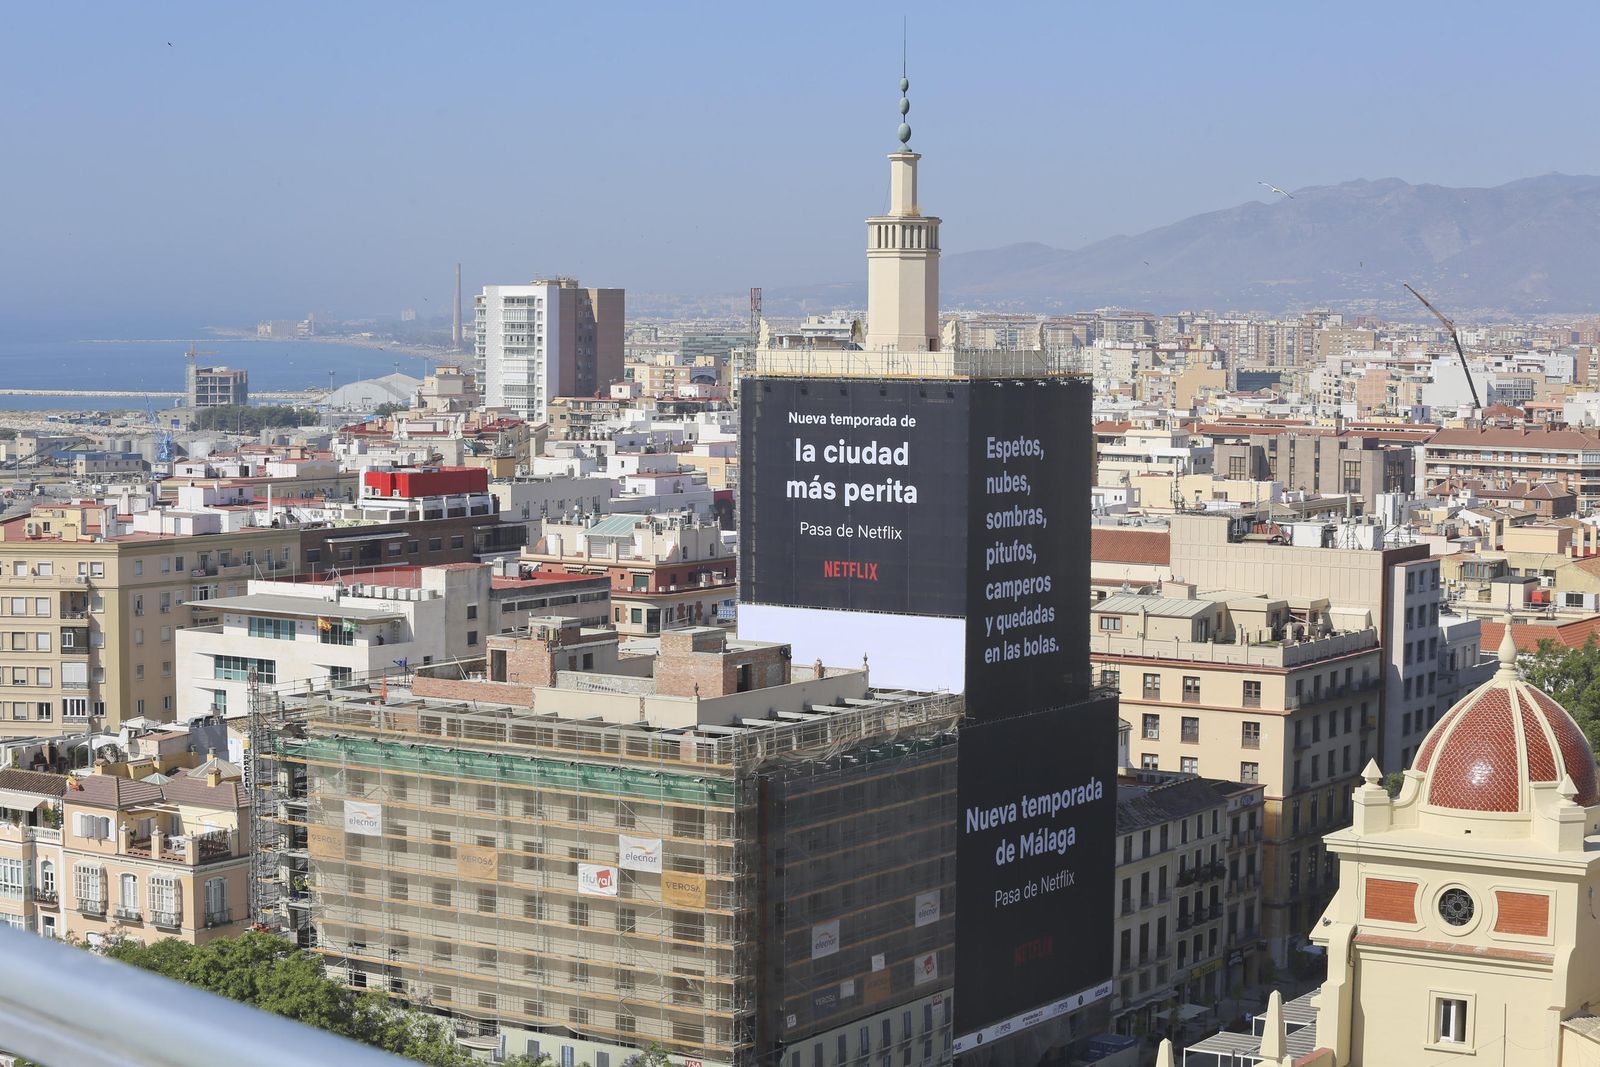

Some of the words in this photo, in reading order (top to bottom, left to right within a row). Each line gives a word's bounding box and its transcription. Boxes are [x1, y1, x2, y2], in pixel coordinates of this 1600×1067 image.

[789, 412, 826, 424] Nueva
[830, 413, 896, 428] temporada
[901, 415, 916, 427] de
[796, 438, 815, 462] la
[824, 439, 908, 465] ciudad
[987, 436, 1044, 462] Espetos,
[787, 475, 836, 500] más
[845, 478, 917, 506] perita
[987, 471, 1030, 495] nubes,
[987, 505, 1046, 529] sombras,
[801, 522, 831, 536] Pasa
[837, 524, 853, 537] de
[859, 525, 902, 539] Netflix
[987, 539, 1036, 570] pitufos,
[824, 560, 877, 581] NETFLIX
[986, 576, 1051, 602] camperos
[986, 617, 993, 637] y
[997, 604, 1054, 635] quedadas
[985, 647, 1000, 663] en
[1004, 641, 1020, 660] las
[1024, 635, 1059, 656] bolas.
[967, 803, 1016, 833] Nueva
[1021, 777, 1102, 818] temporada
[349, 816, 378, 827] elecnor
[625, 852, 657, 863] elecnor
[996, 839, 1015, 865] de
[1020, 827, 1075, 858] Málaga
[665, 882, 701, 892] VEROSA
[995, 889, 1020, 908] Pasa
[1024, 881, 1037, 899] de
[1041, 870, 1074, 893] Netflix
